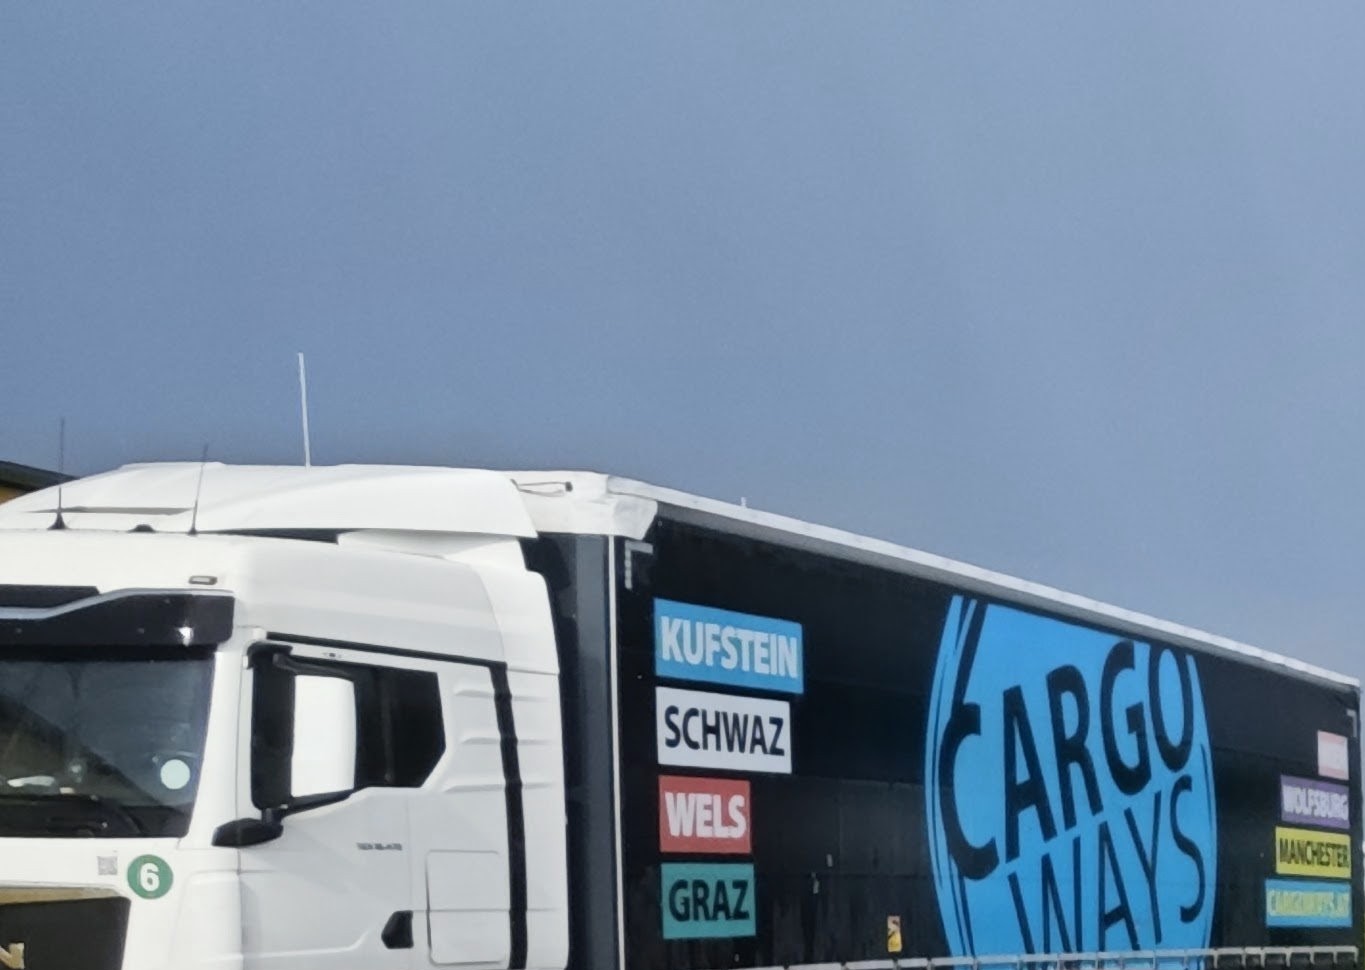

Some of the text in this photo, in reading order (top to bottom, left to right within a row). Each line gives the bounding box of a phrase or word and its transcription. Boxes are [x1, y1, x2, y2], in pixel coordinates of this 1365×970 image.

[660, 615, 799, 679] KUFSTEIN
[664, 705, 785, 756] SCHWAZ
[938, 640, 1195, 881] CARGO
[665, 791, 748, 838] WELS
[1281, 783, 1349, 822] WOLFSBURG
[1279, 837, 1350, 869] MANCHESTER
[140, 862, 161, 892] 6
[668, 879, 750, 922] GRAZ
